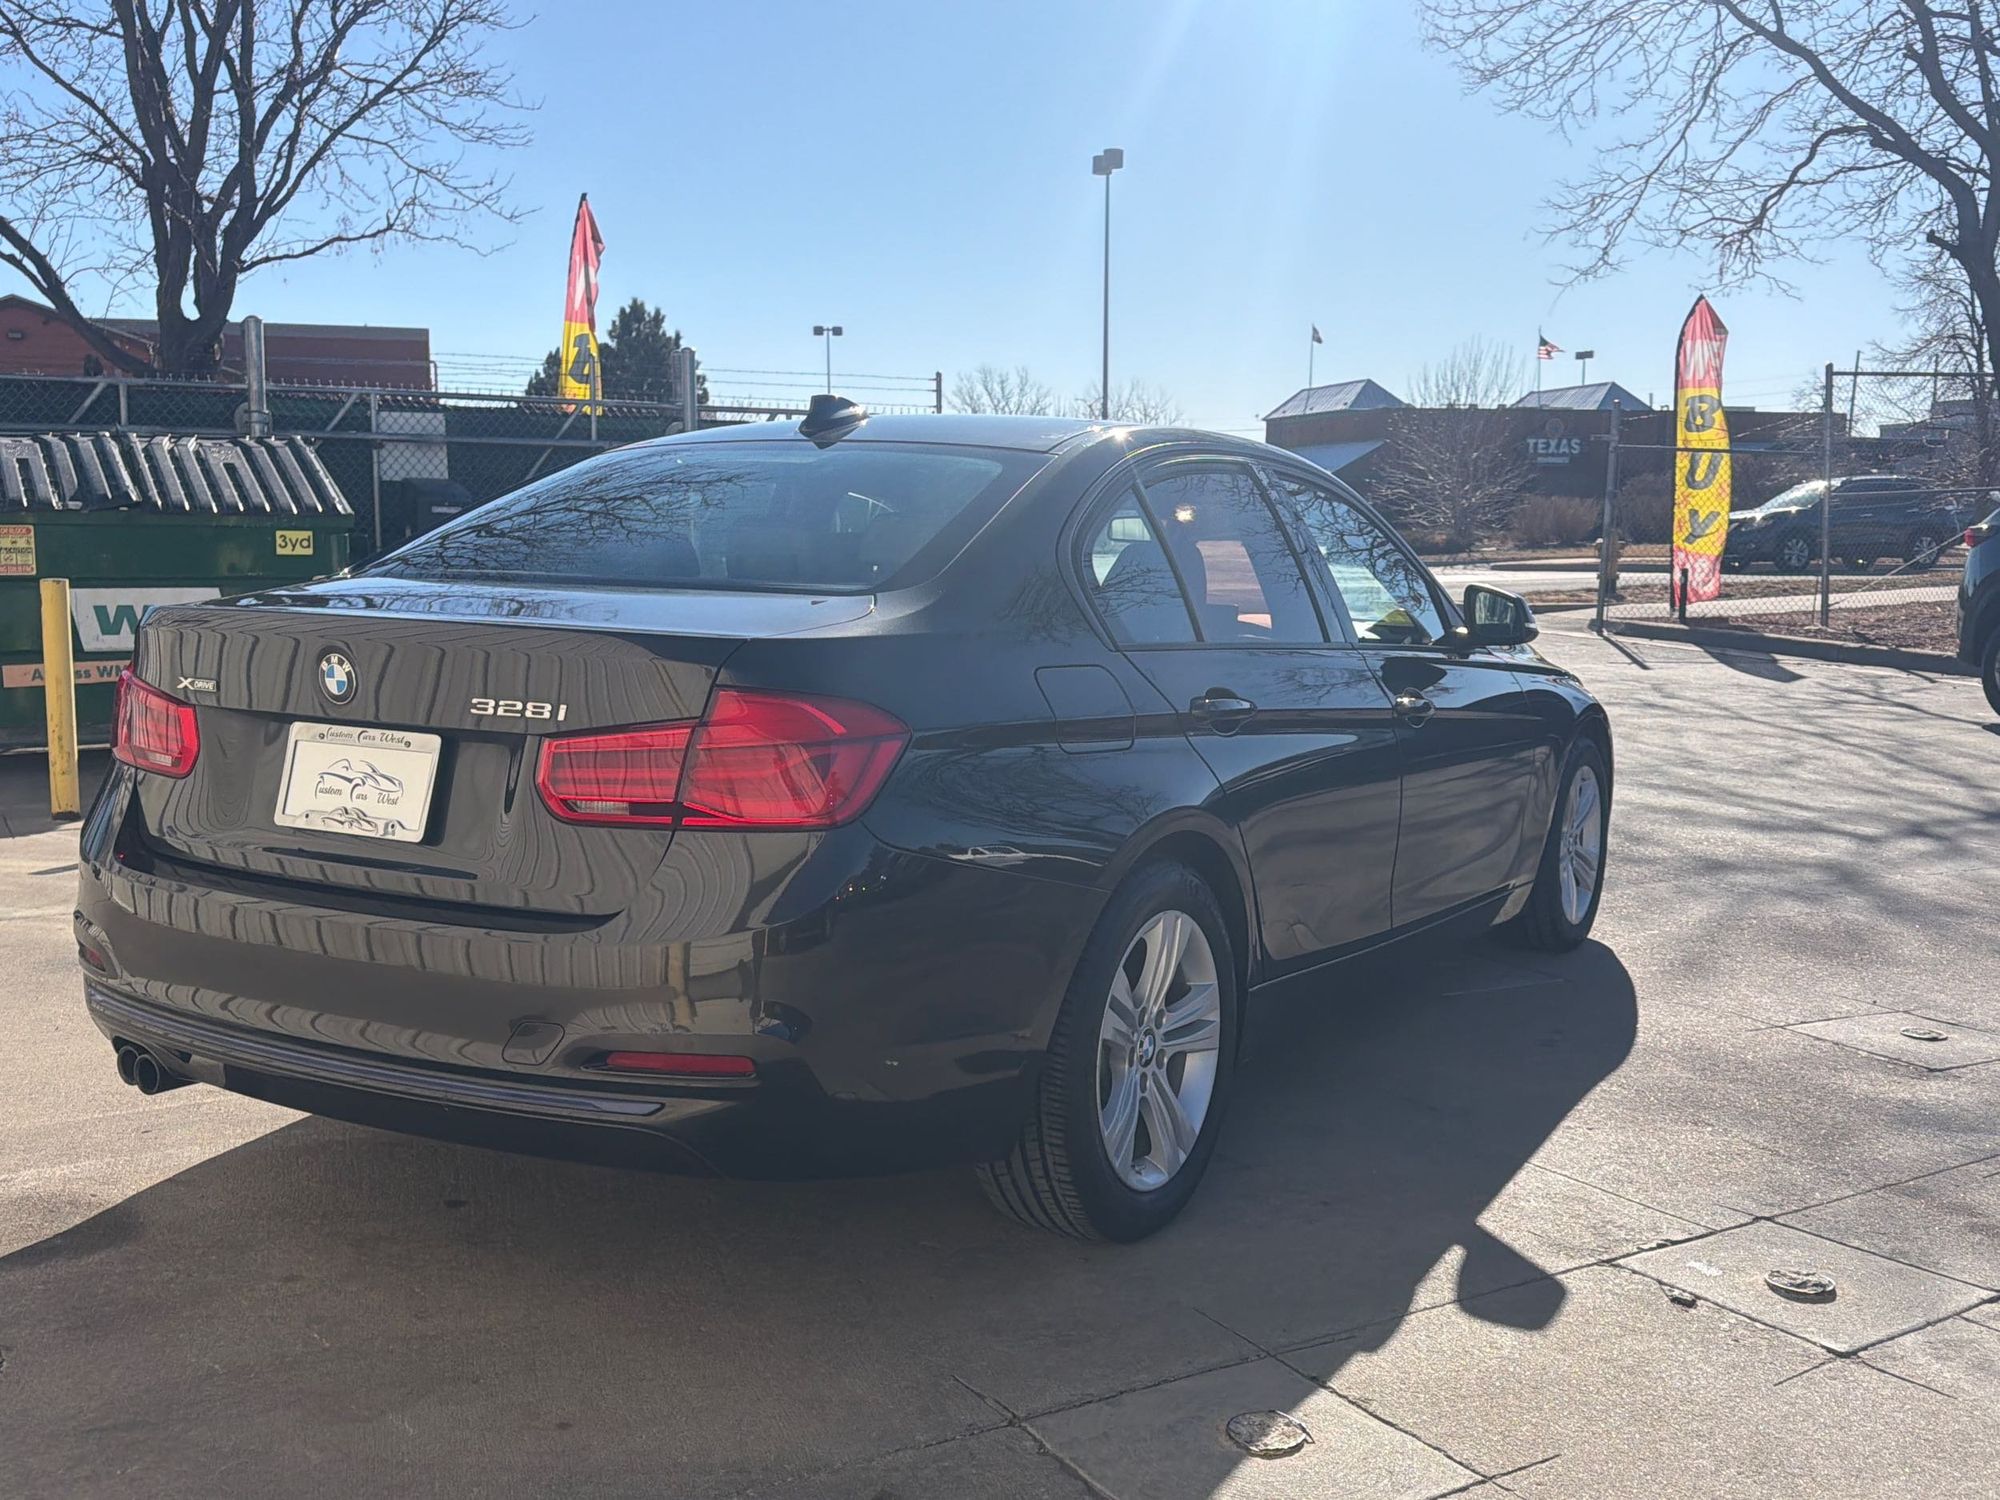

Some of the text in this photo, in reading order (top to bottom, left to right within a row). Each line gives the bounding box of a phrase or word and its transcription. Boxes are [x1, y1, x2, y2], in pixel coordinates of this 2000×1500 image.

[1526, 438, 1581, 454] TEXAS
[1684, 395, 1722, 545] BUY
[278, 534, 311, 552] 3yd
[321, 655, 351, 672] BMW
[326, 727, 405, 744] Custom Cars West
[315, 780, 400, 805] Custom Cars West
